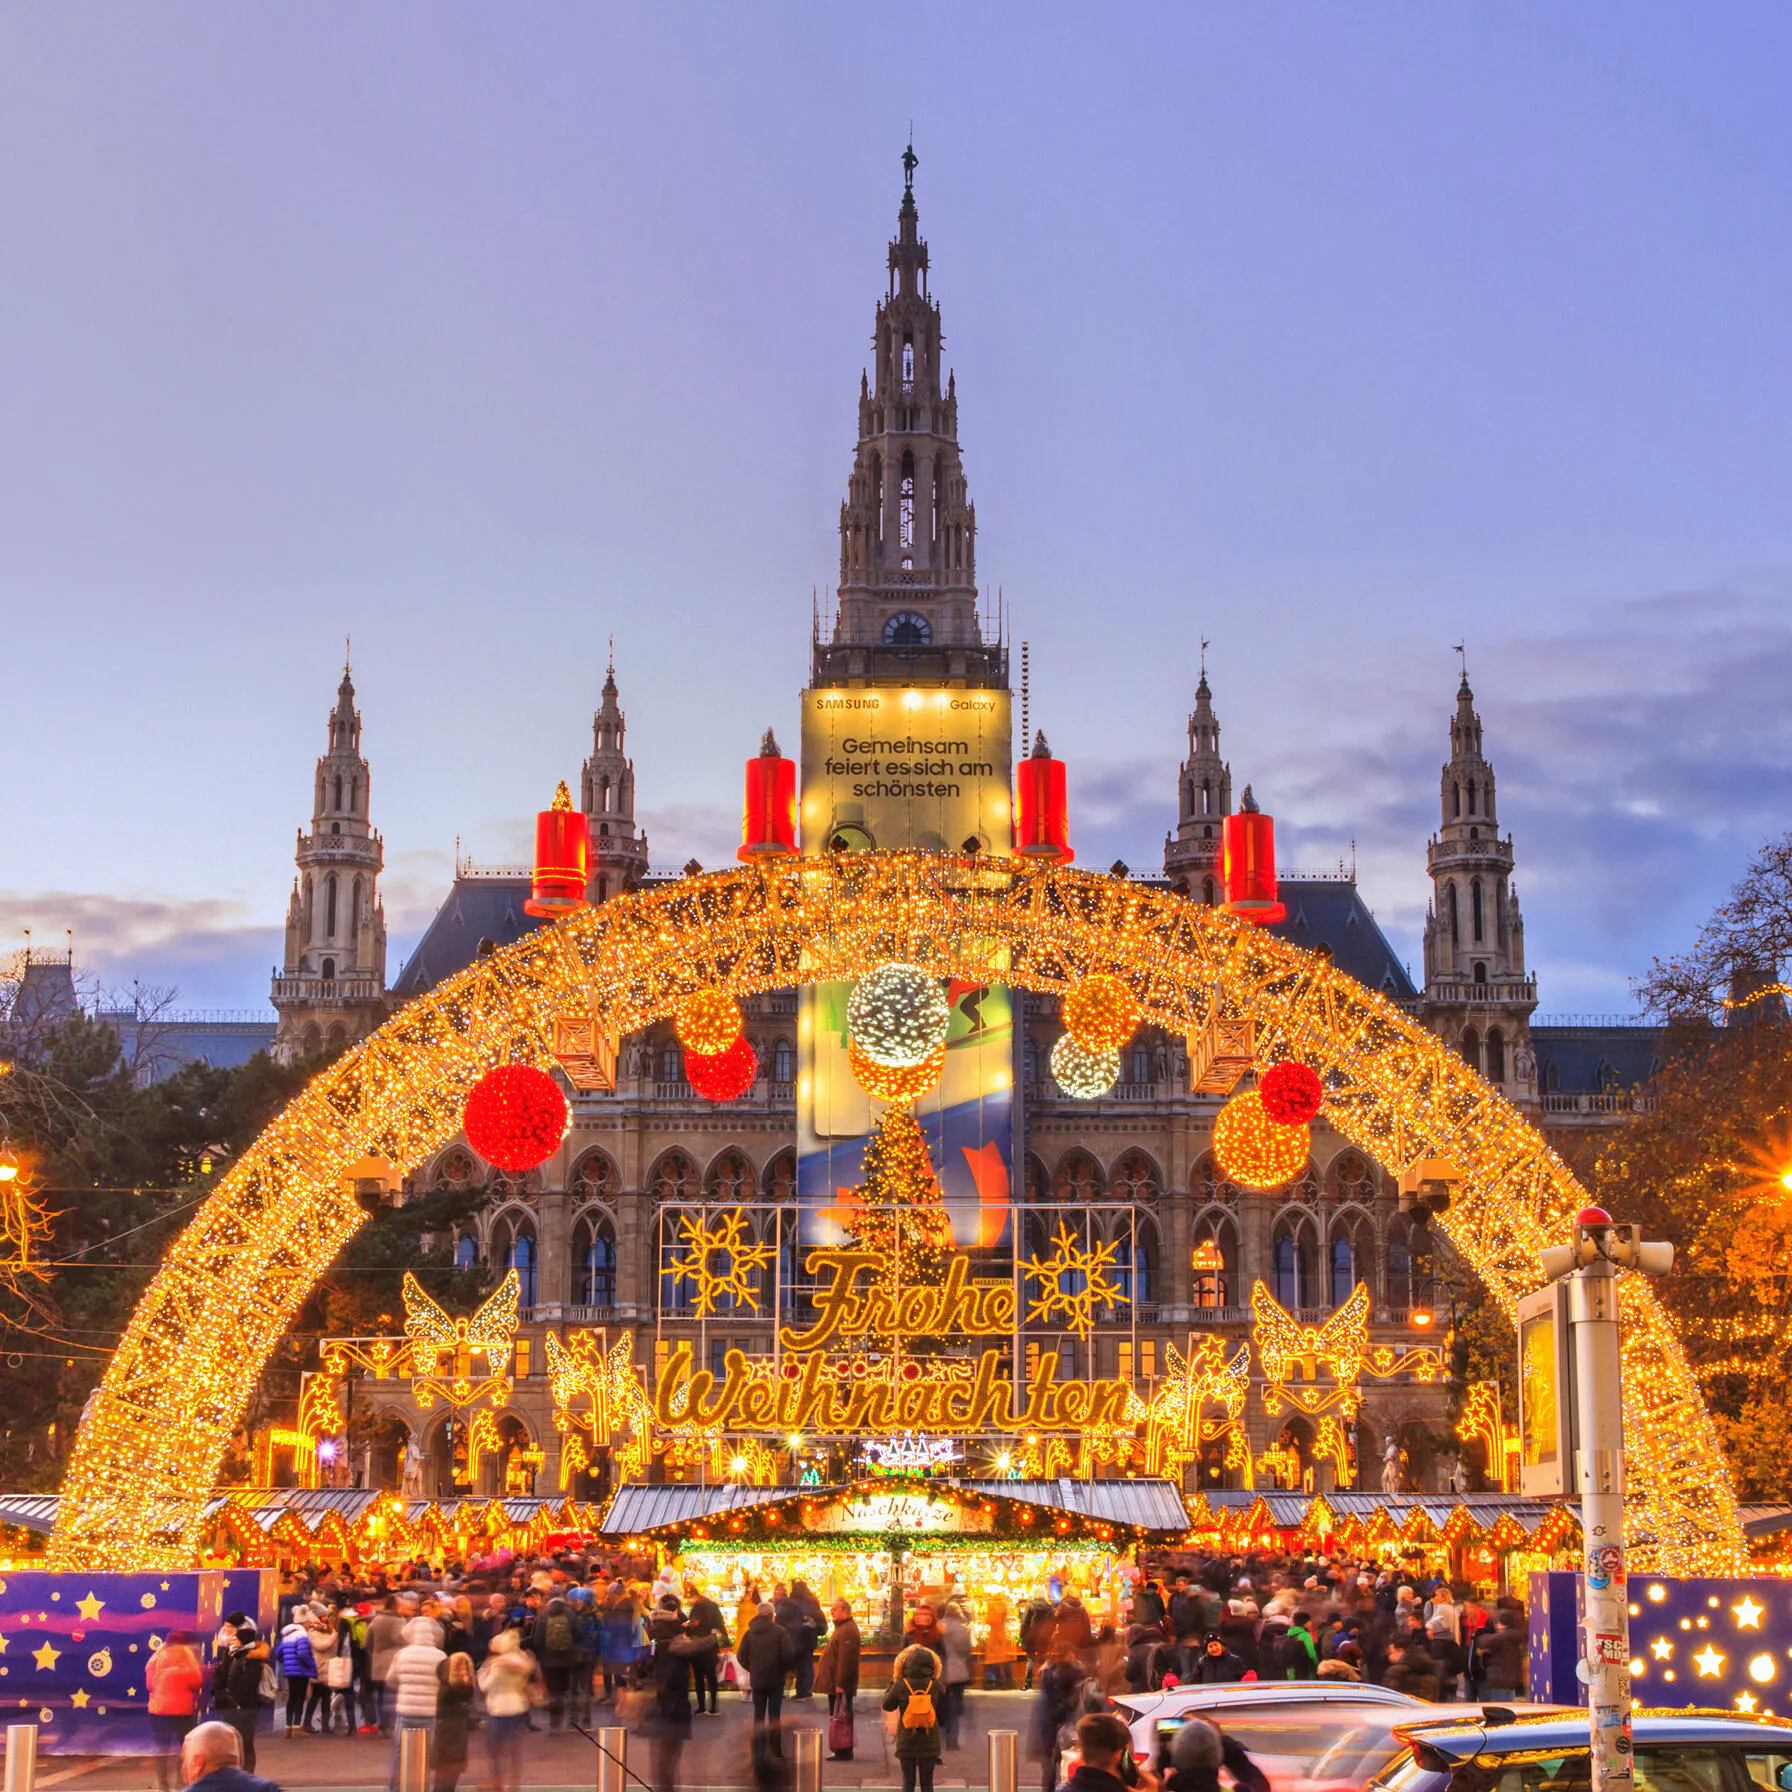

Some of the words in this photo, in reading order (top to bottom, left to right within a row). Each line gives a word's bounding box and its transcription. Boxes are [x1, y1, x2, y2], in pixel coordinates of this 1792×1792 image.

[816, 699, 880, 710] SAMSUNG
[949, 699, 996, 712] Galaxy
[842, 737, 968, 754] Gemeinsam
[825, 758, 881, 776] feiert
[885, 764, 910, 776] es
[914, 758, 954, 776] sich
[959, 764, 993, 776] am
[853, 779, 960, 797] schönsten
[778, 1250, 1018, 1351] Frohe
[656, 1348, 1135, 1430] Weihnachten
